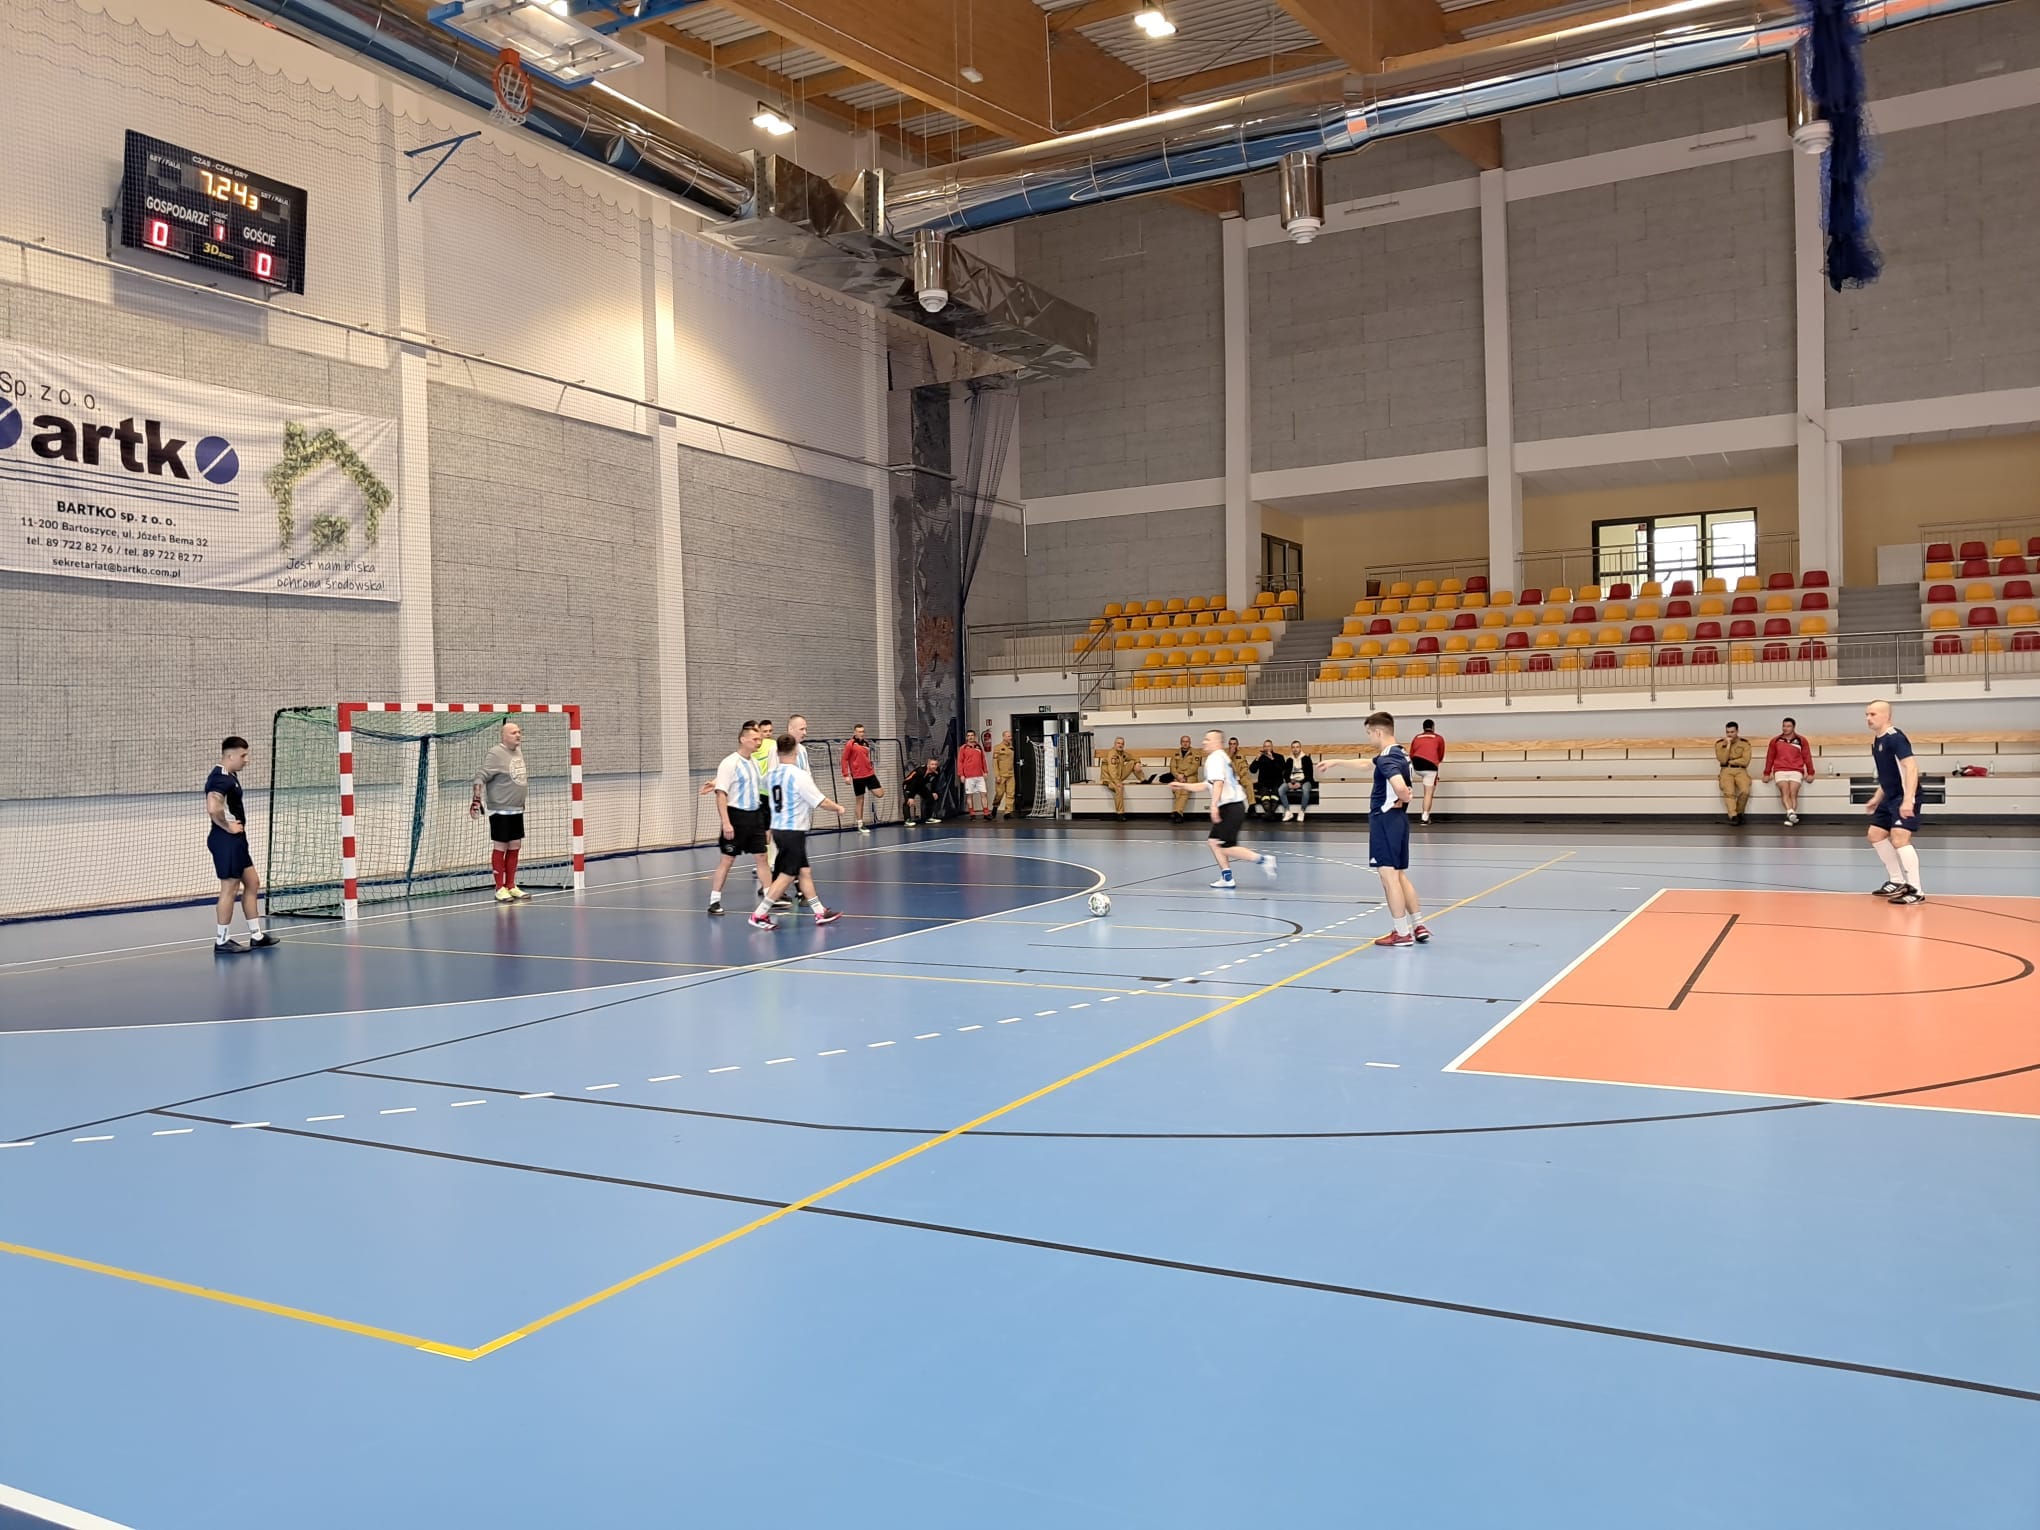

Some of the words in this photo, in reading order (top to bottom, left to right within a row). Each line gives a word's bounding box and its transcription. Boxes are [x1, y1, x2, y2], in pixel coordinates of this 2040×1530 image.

[192, 156, 211, 167] CZAS
[215, 163, 234, 175] CZAS
[234, 170, 249, 180] GRY
[146, 196, 210, 227] GOSPODARZE
[152, 221, 169, 247] 0
[217, 225, 224, 241] 1
[243, 226, 277, 247] GOŚCIE
[256, 252, 272, 277] 0
[0, 371, 33, 400] Sp.
[40, 384, 51, 402] z
[59, 389, 77, 407] o.
[84, 394, 102, 412] o.
[57, 500, 116, 519] BARTKO
[120, 511, 138, 523] sp.
[141, 514, 148, 523] z
[151, 516, 162, 525] o.
[165, 517, 176, 527] o.
[21, 517, 58, 530] 11-200
[62, 521, 120, 539] Bartoszyce,
[122, 529, 134, 540] ul.
[136, 530, 166, 544] Józefa
[169, 534, 194, 547] Bema
[196, 537, 208, 547] 32
[27, 536, 41, 546] tel.
[46, 537, 59, 548] 89
[63, 539, 82, 551] 722
[85, 541, 97, 552] 82
[101, 543, 113, 554] 76
[124, 547, 140, 557] tel.
[142, 548, 155, 559] 89
[158, 550, 175, 560] 722
[178, 552, 190, 562] 82
[192, 553, 203, 563] 77
[52, 557, 181, 578] sekretariat@bartko.com.pl
[286, 557, 313, 570] Jest
[318, 561, 341, 571] nam
[344, 560, 376, 573] bliska
[276, 576, 321, 590] ochrona
[772, 784, 783, 813] 9
